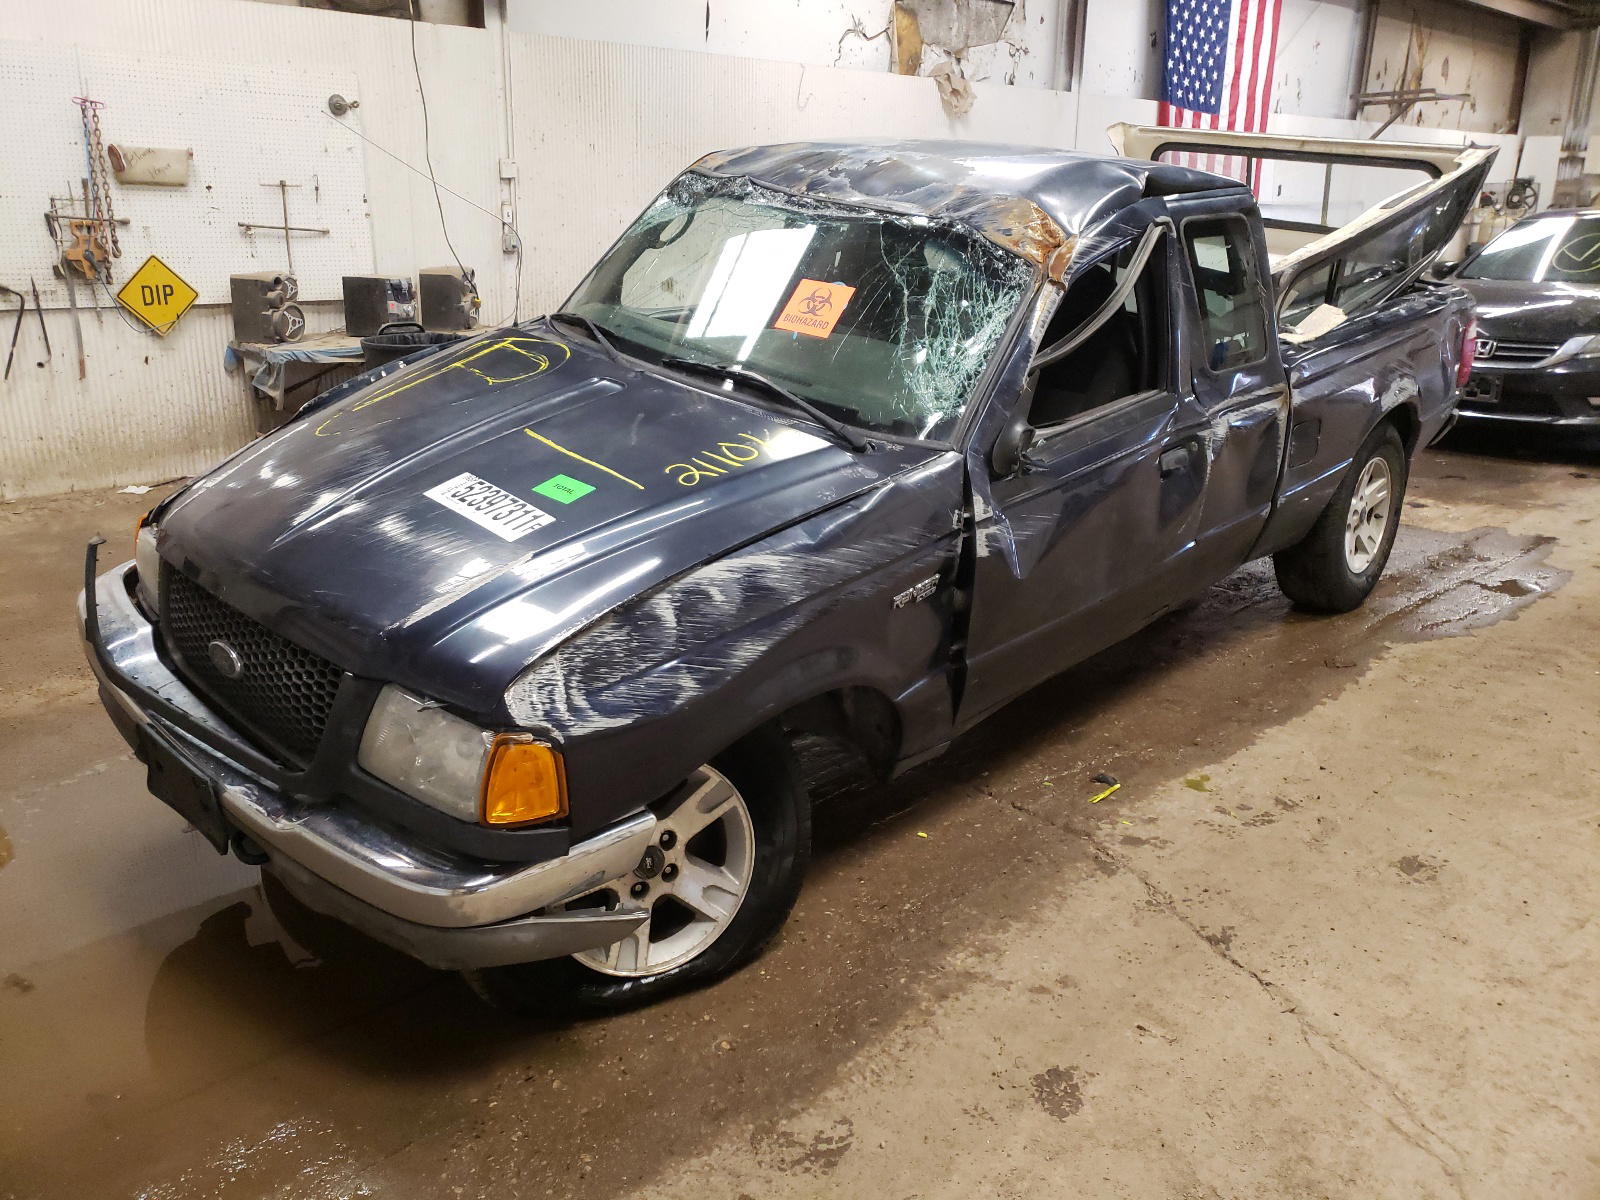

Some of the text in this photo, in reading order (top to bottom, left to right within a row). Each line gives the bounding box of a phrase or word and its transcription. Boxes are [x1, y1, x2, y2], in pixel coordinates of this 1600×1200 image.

[141, 283, 175, 307] DIP
[783, 313, 829, 330] BIOHAZARD
[553, 482, 575, 496] TOTAL
[450, 480, 546, 531] 52397311
